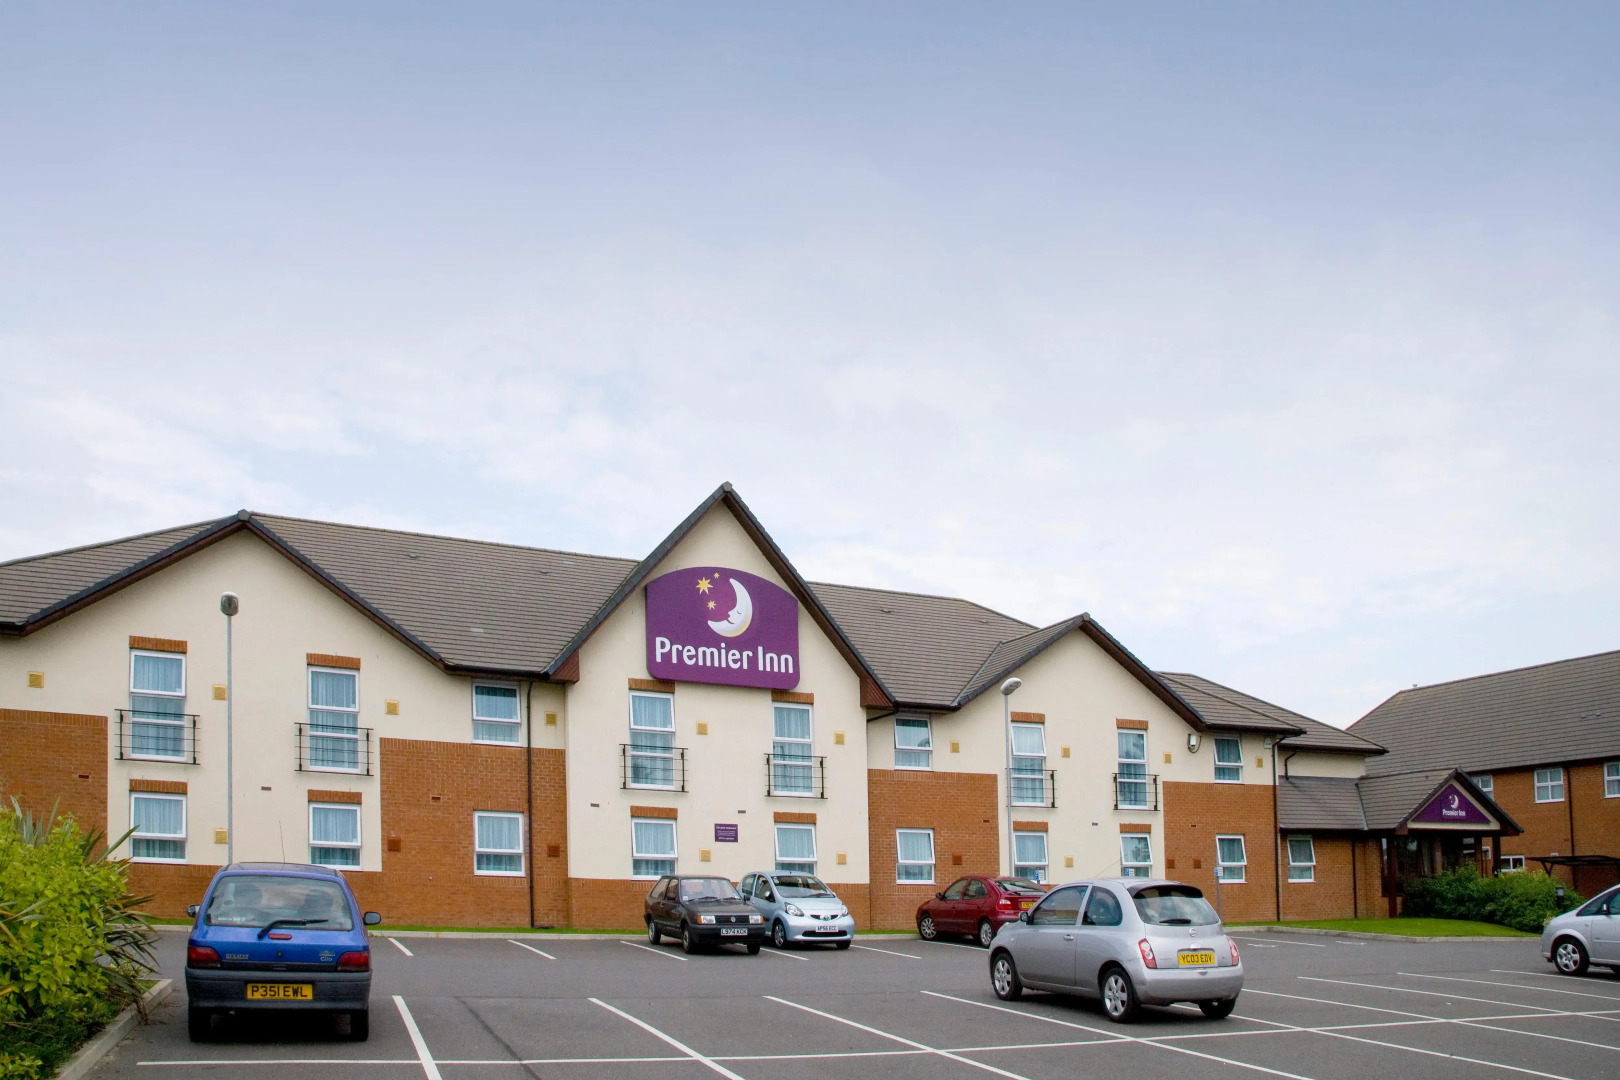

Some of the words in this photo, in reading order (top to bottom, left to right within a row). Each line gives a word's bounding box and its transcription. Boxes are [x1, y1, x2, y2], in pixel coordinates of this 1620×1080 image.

[655, 636, 753, 670] Premier
[757, 646, 794, 674] Inn
[1181, 954, 1200, 964] YC03
[1200, 953, 1212, 963] EDV
[251, 985, 280, 998] P351
[283, 985, 308, 998] EWL
